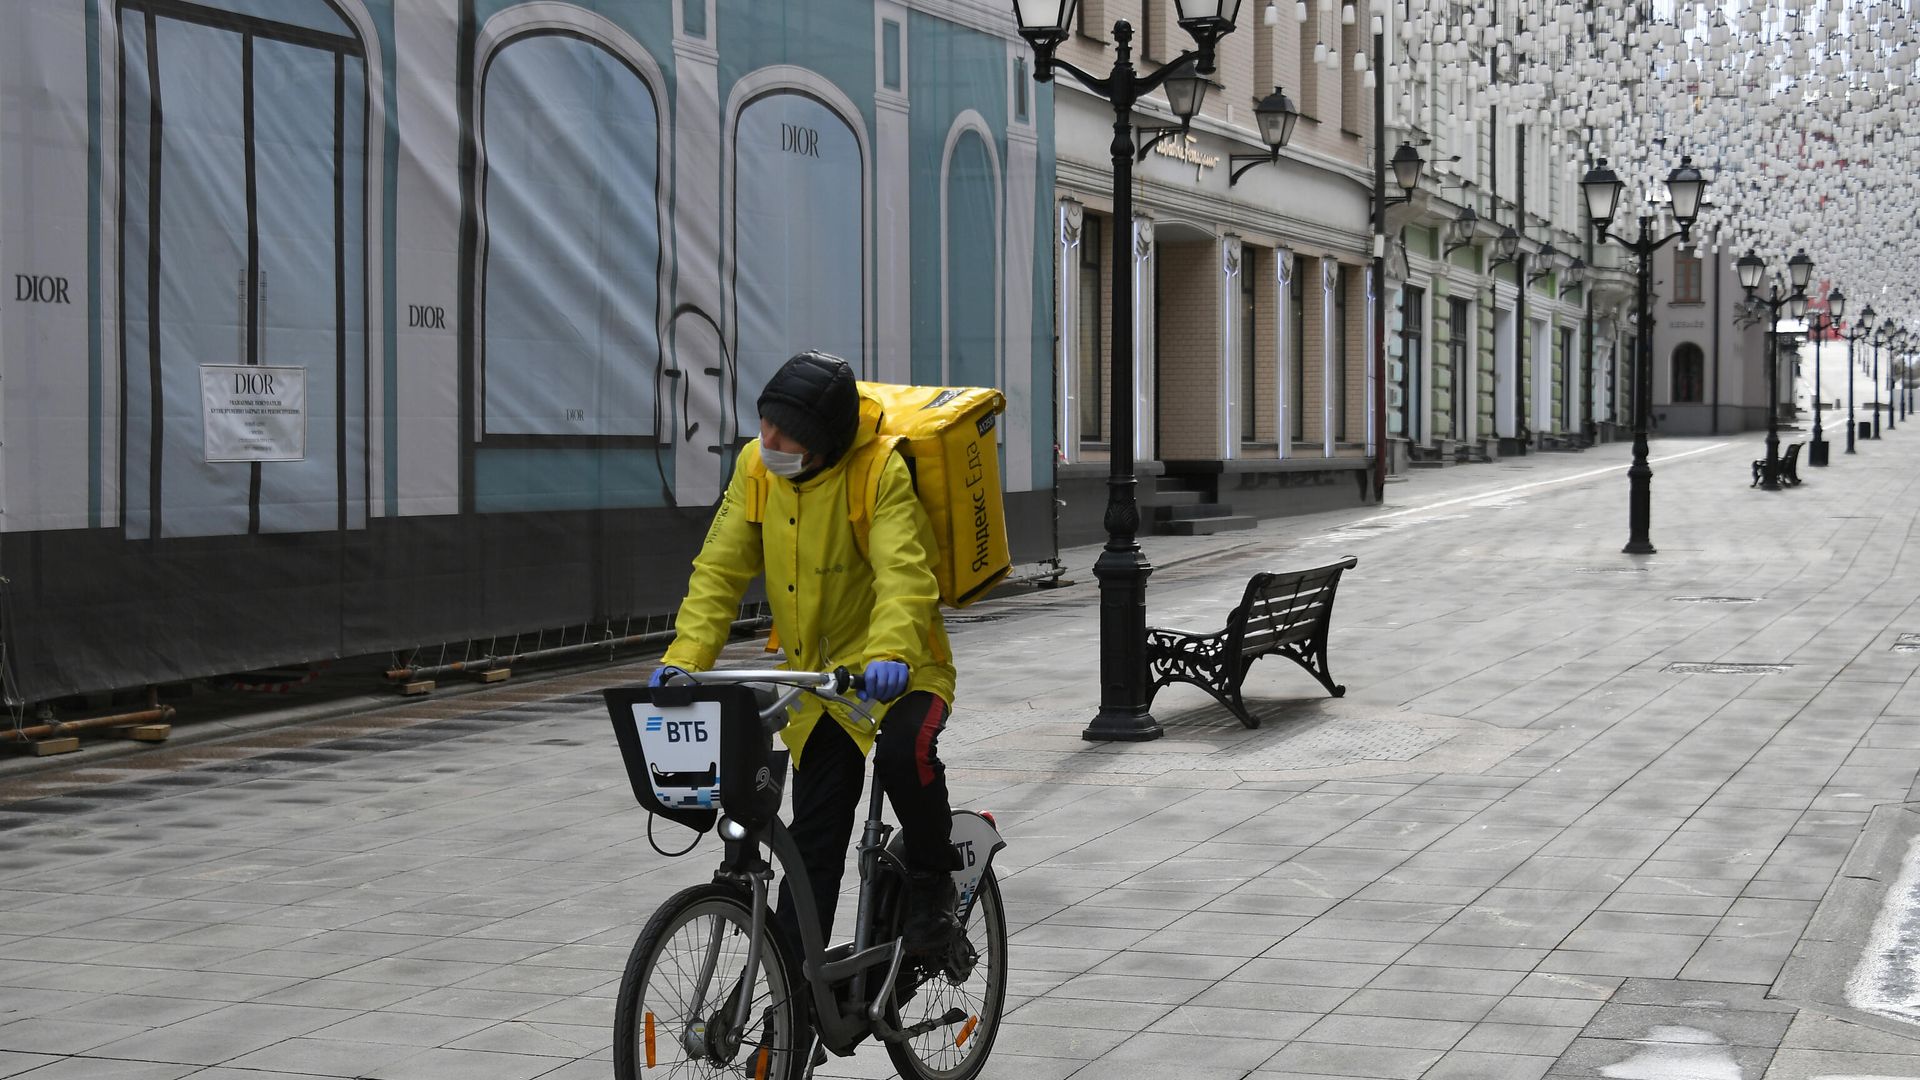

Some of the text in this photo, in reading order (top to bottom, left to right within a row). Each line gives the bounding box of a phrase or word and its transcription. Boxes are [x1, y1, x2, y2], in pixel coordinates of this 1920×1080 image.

[782, 123, 820, 158] DIOR
[15, 274, 71, 304] DIOR
[409, 304, 446, 330] DIOR
[234, 373, 275, 395] DIOR
[965, 440, 991, 573] Яндекс Еда
[666, 720, 708, 743] ВТБ
[956, 840, 976, 868] ТБ
